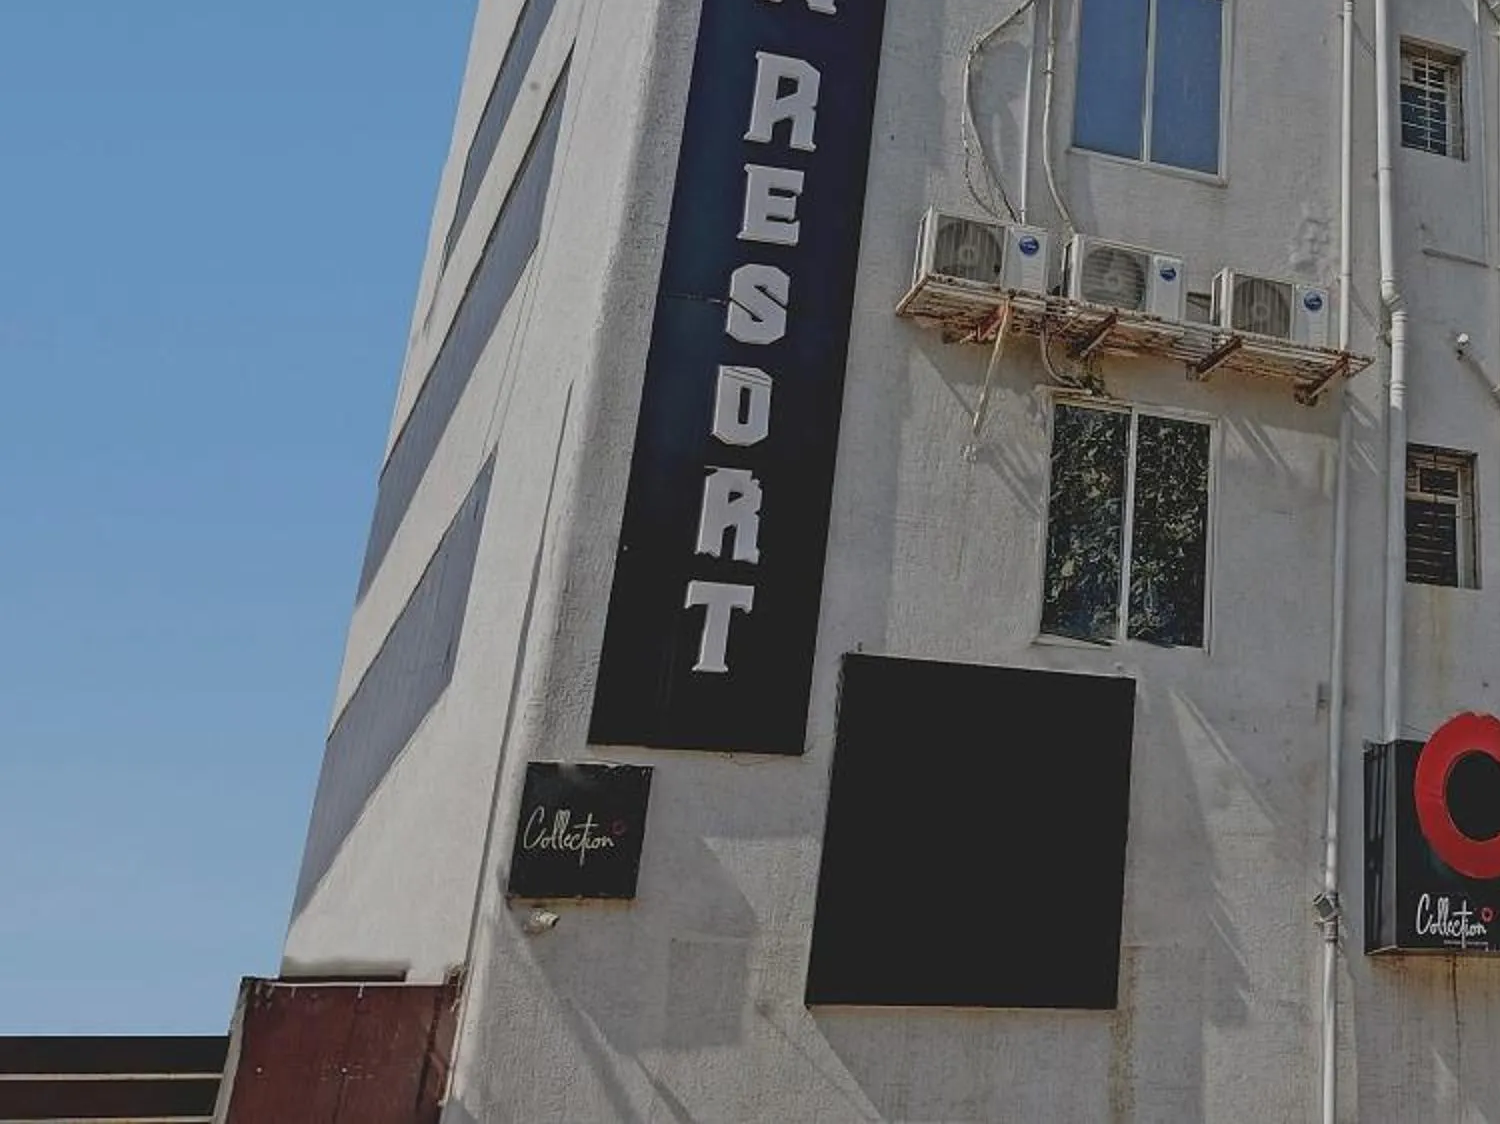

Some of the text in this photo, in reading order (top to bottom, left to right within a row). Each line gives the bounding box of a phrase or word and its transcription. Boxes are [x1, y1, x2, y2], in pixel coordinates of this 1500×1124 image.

[683, 50, 822, 674] RESORT
[523, 805, 615, 868] Collection
[1415, 893, 1487, 949] Collection
